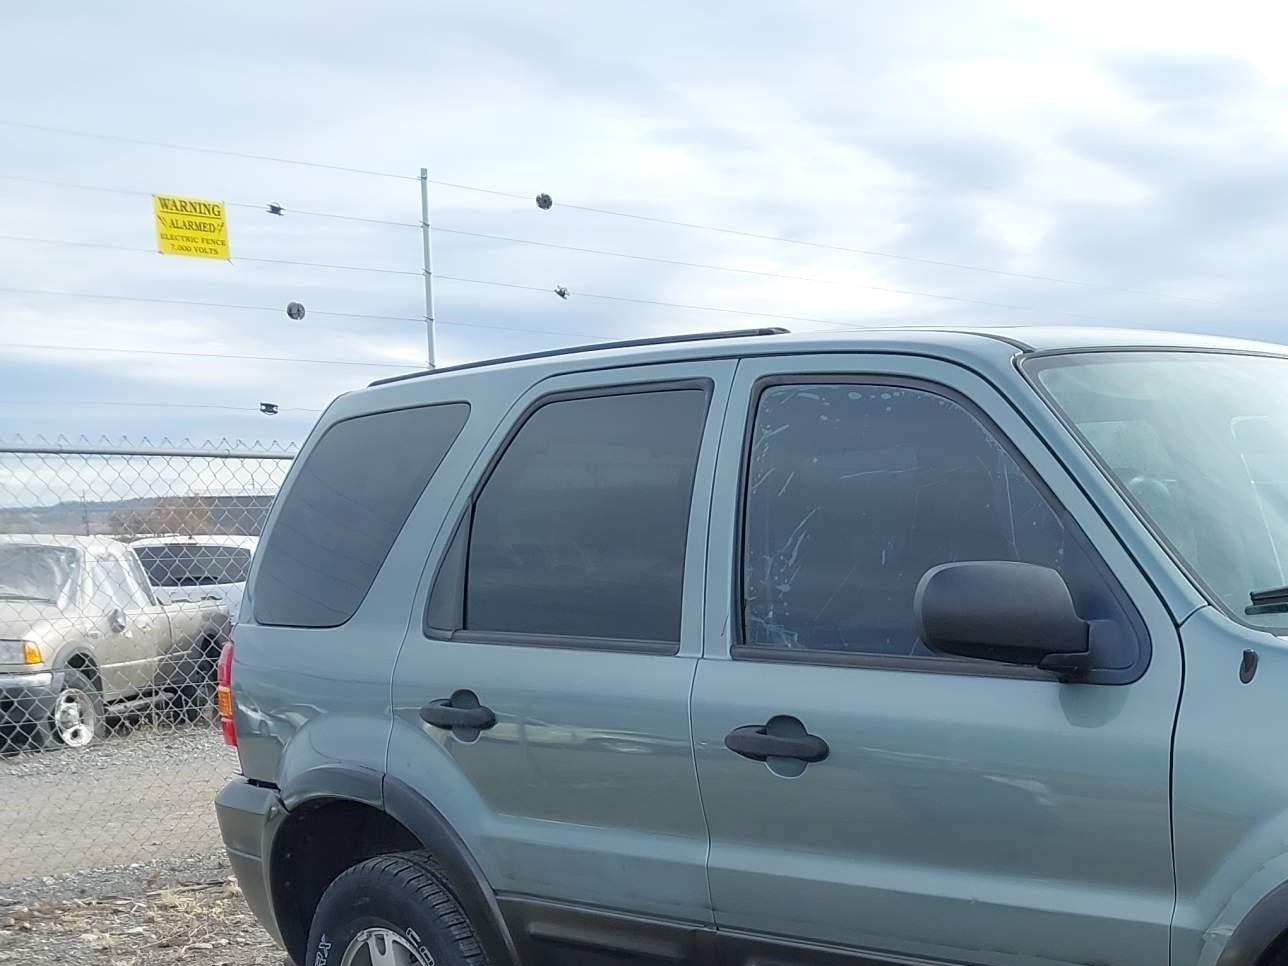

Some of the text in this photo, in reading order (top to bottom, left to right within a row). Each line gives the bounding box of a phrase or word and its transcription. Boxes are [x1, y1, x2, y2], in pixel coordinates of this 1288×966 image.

[158, 197, 221, 216] WARNING
[169, 218, 216, 233] ALARMED
[160, 233, 226, 246] ELECTRIC FENCE
[193, 246, 219, 255] VOLTS
